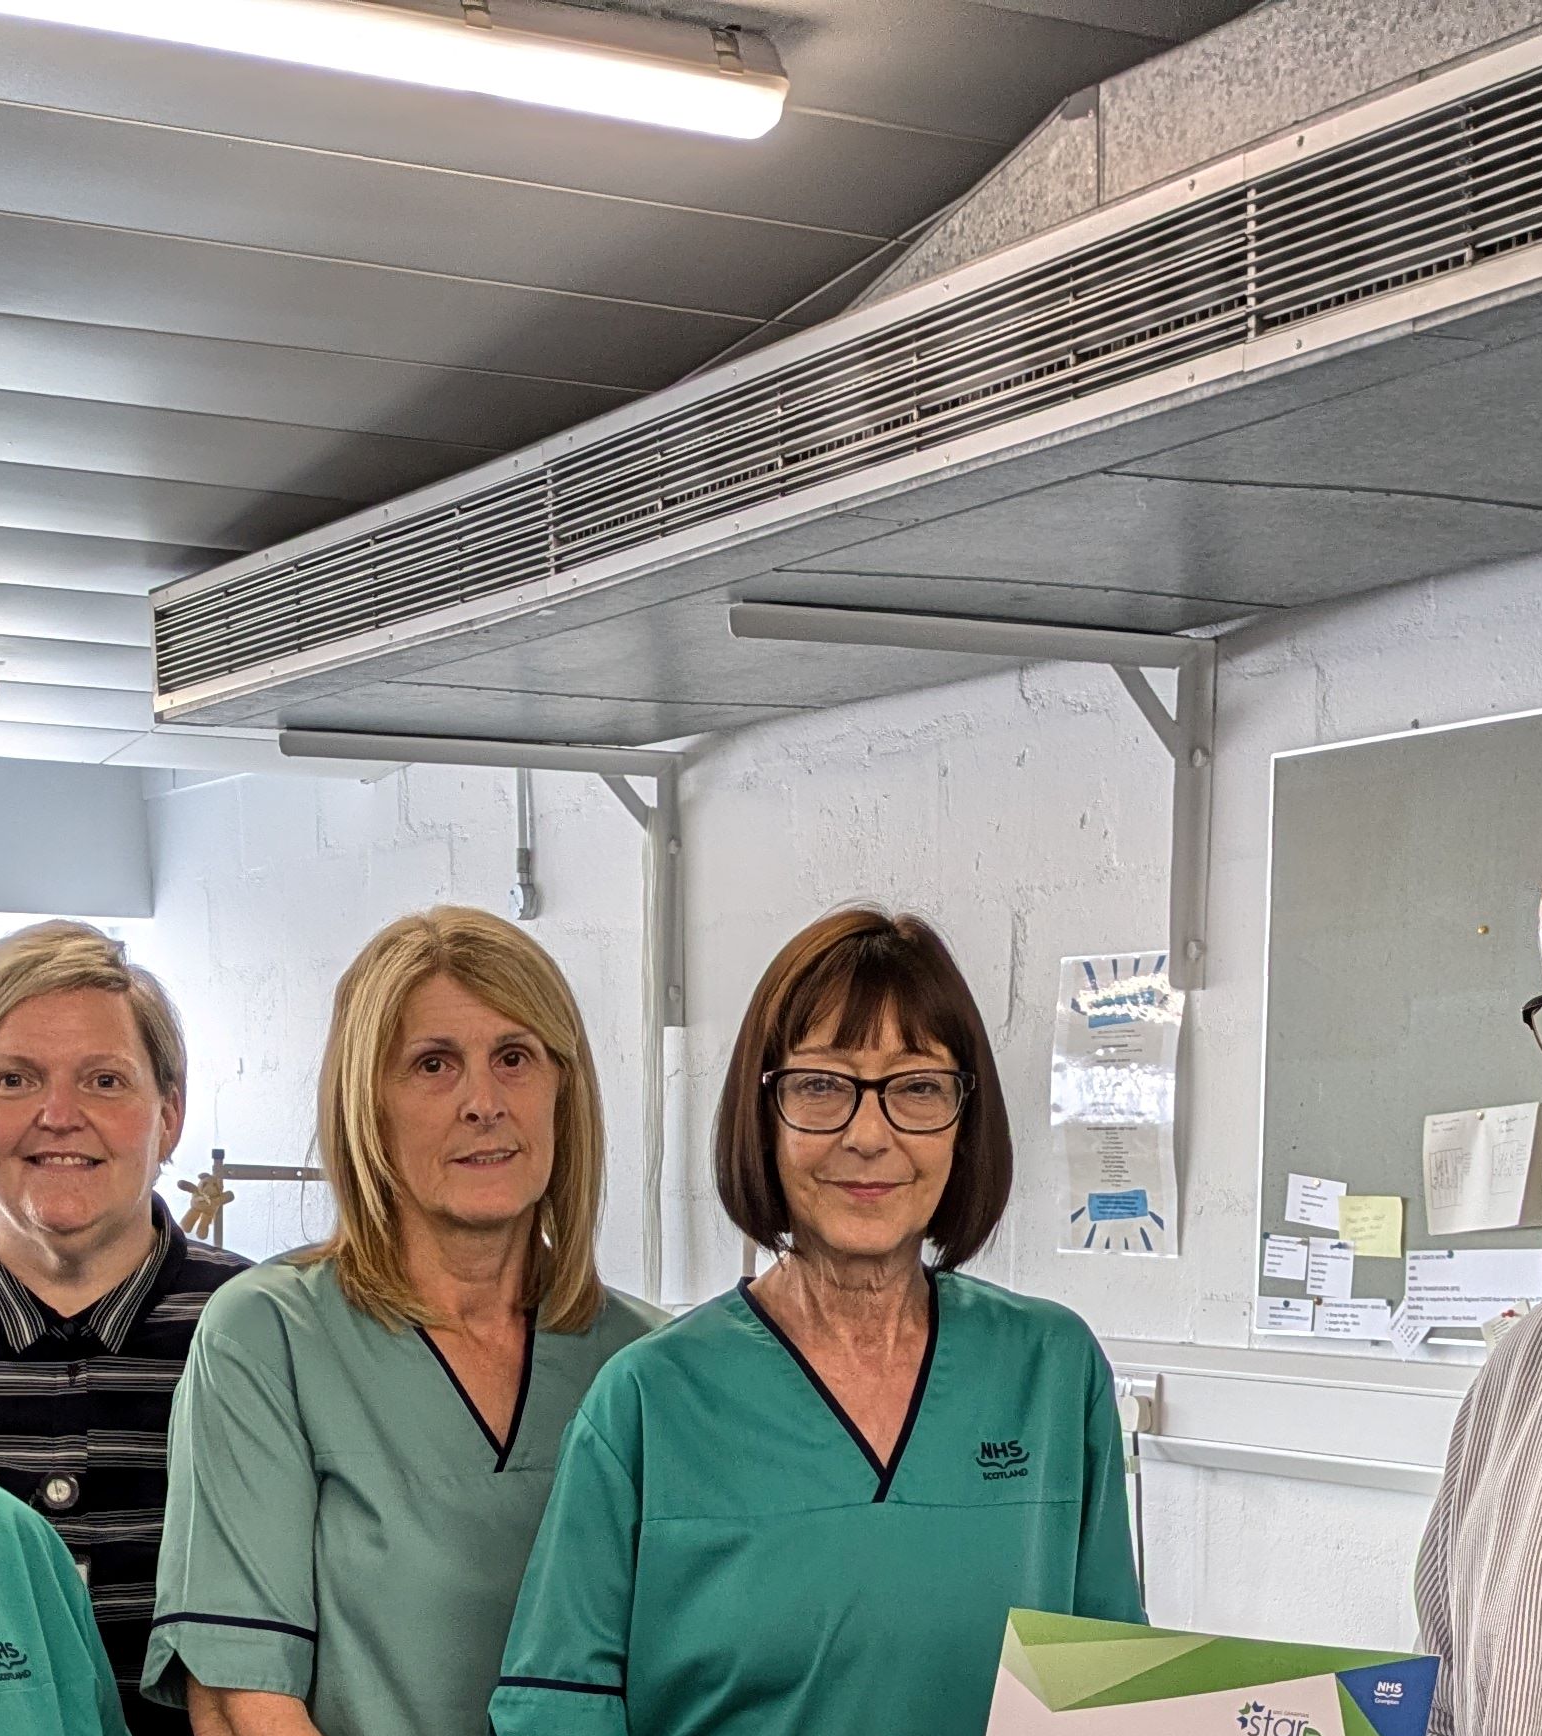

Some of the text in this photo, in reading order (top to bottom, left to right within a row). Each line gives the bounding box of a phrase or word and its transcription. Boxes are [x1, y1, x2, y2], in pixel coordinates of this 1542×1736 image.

[981, 1440, 1022, 1459] NHS
[982, 1468, 1028, 1481] SCOTLAND
[1377, 1681, 1402, 1693] NHS
